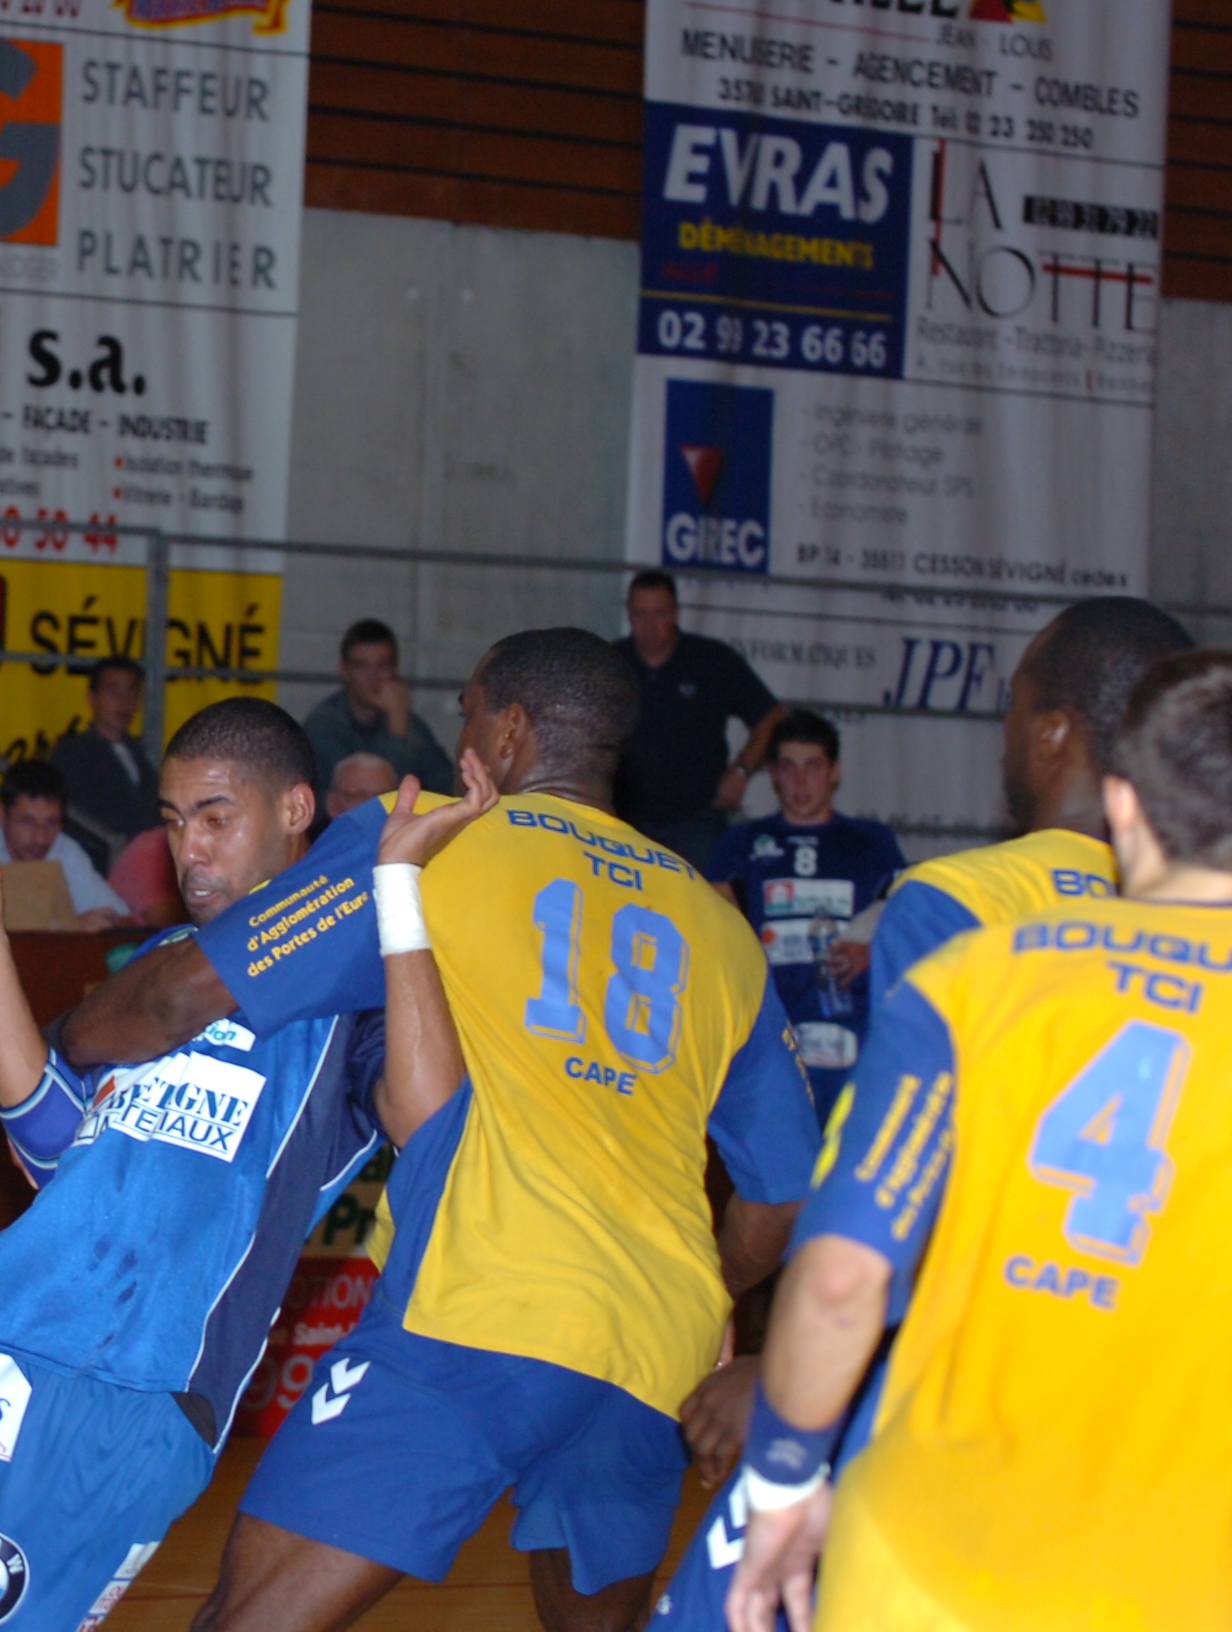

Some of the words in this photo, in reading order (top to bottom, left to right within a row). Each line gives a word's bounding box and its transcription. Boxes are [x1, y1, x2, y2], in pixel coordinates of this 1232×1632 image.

[81, 58, 268, 121] STAFFEUR
[77, 145, 274, 207] STUCATEUR
[662, 123, 895, 226] EVRAS
[76, 228, 277, 291] PLATRIER
[26, 328, 148, 397] s.a.
[656, 308, 708, 351] 02
[750, 317, 792, 362] 23
[800, 322, 845, 366] 66
[848, 328, 890, 370] 66
[29, 594, 270, 686] SÉVGNÉ
[505, 809, 698, 882] BOUQUET
[583, 851, 644, 891] TCI
[794, 845, 817, 877] 8
[247, 877, 356, 952] d'Agglomération
[248, 875, 329, 928] Communauté
[247, 955, 275, 978] des
[270, 927, 318, 961] Portes
[316, 915, 337, 933] de
[523, 876, 693, 1077] 18
[1105, 959, 1206, 1017] TCI
[564, 1056, 638, 1097] CAPE
[1024, 1016, 1195, 1270] 4
[1002, 1255, 1122, 1312] CAPE
